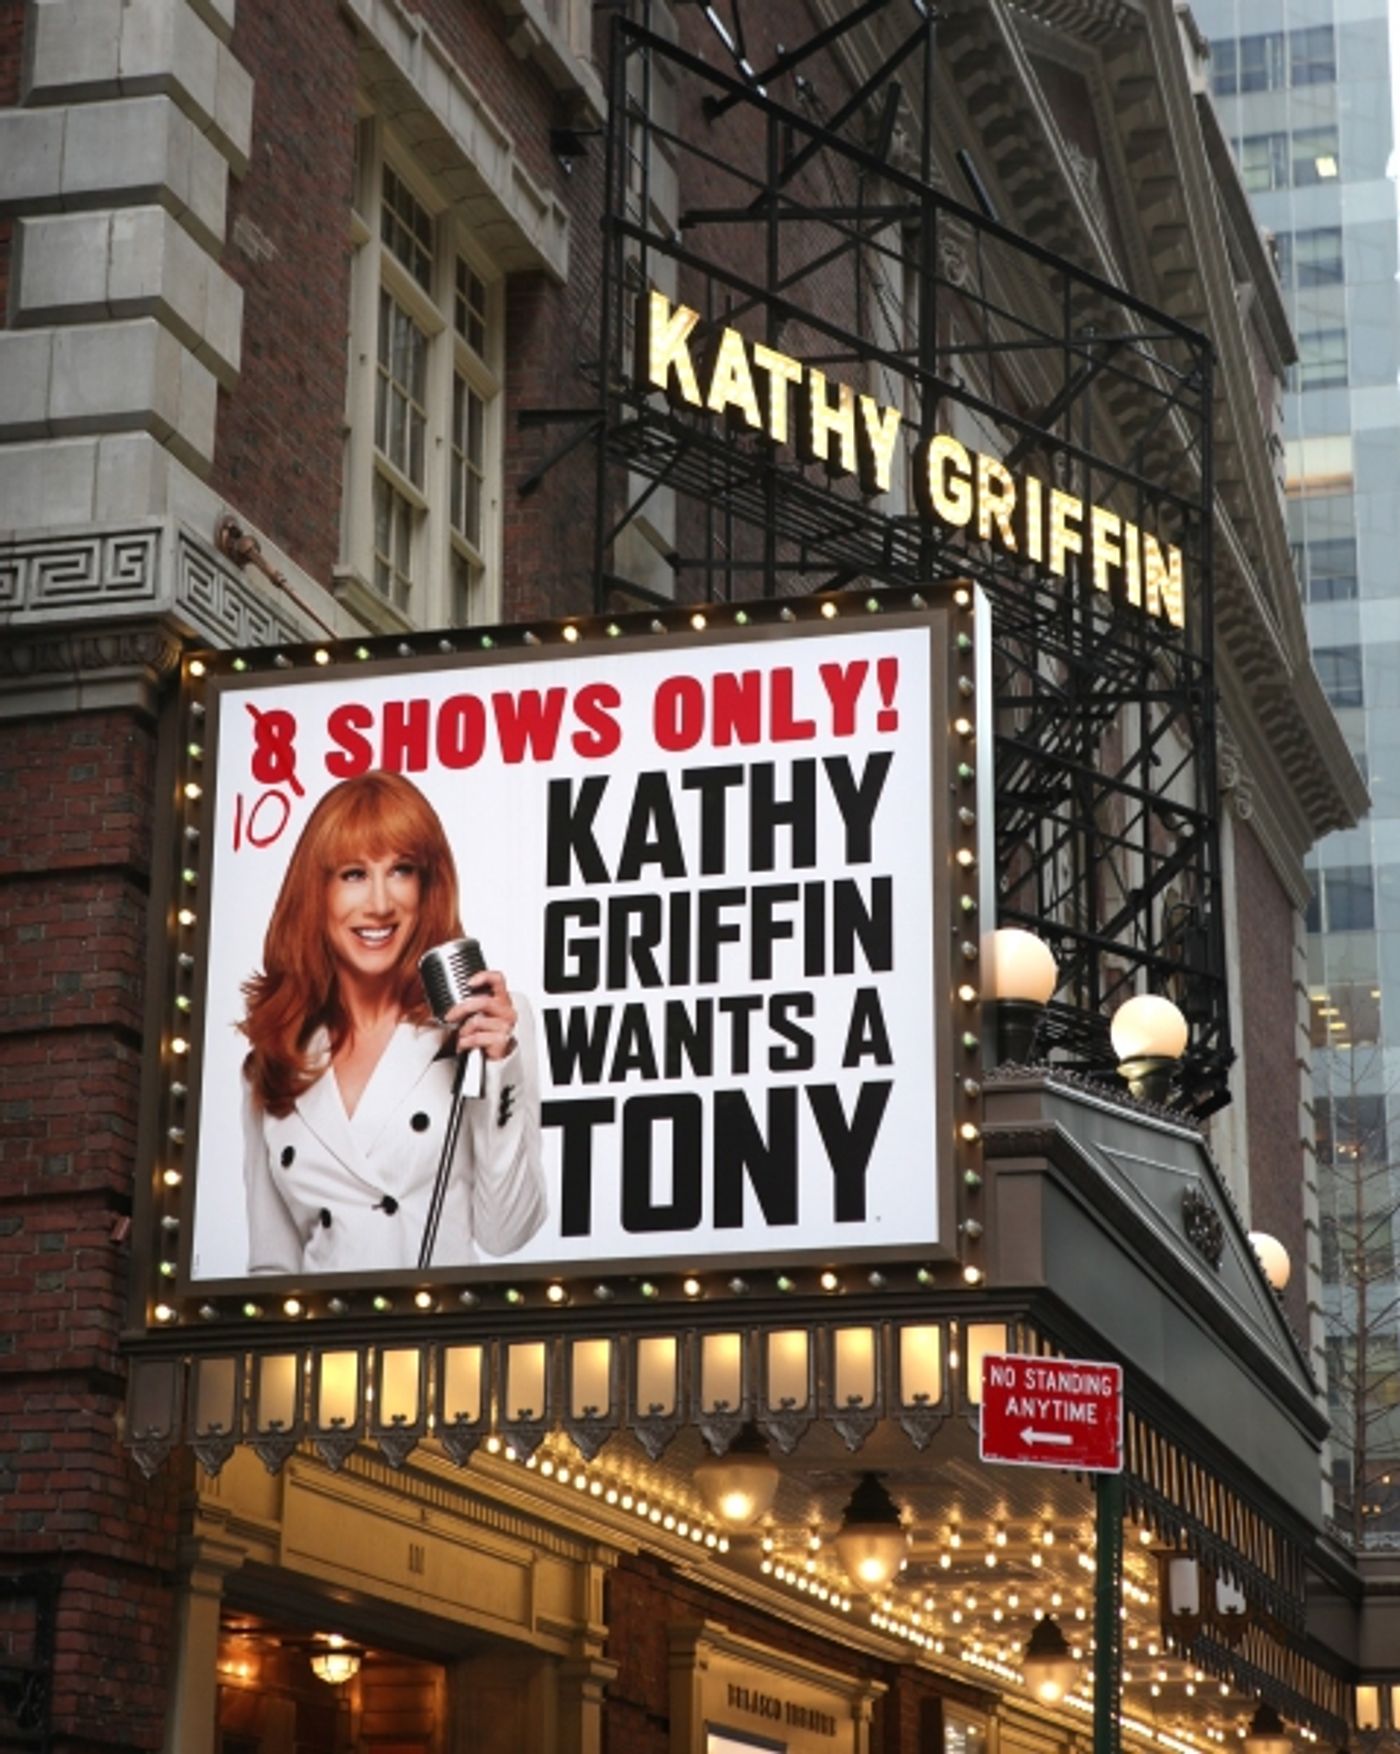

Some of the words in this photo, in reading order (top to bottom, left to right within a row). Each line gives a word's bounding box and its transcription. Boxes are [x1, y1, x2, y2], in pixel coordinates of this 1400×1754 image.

[649, 290, 903, 493] KATHY
[927, 434, 1185, 628] GRIFFIN
[324, 683, 622, 779] SHOWS
[653, 657, 899, 752] ONLY!
[233, 788, 290, 851] 10
[546, 751, 894, 887] KATHY
[543, 875, 893, 995] GRIFFIN
[543, 991, 816, 1087] WANTS
[841, 987, 894, 1068] A
[539, 1079, 894, 1238] TONY
[990, 1365, 1016, 1388] NO
[1024, 1368, 1112, 1398] STANDING
[1005, 1396, 1099, 1425] ANYTIME
